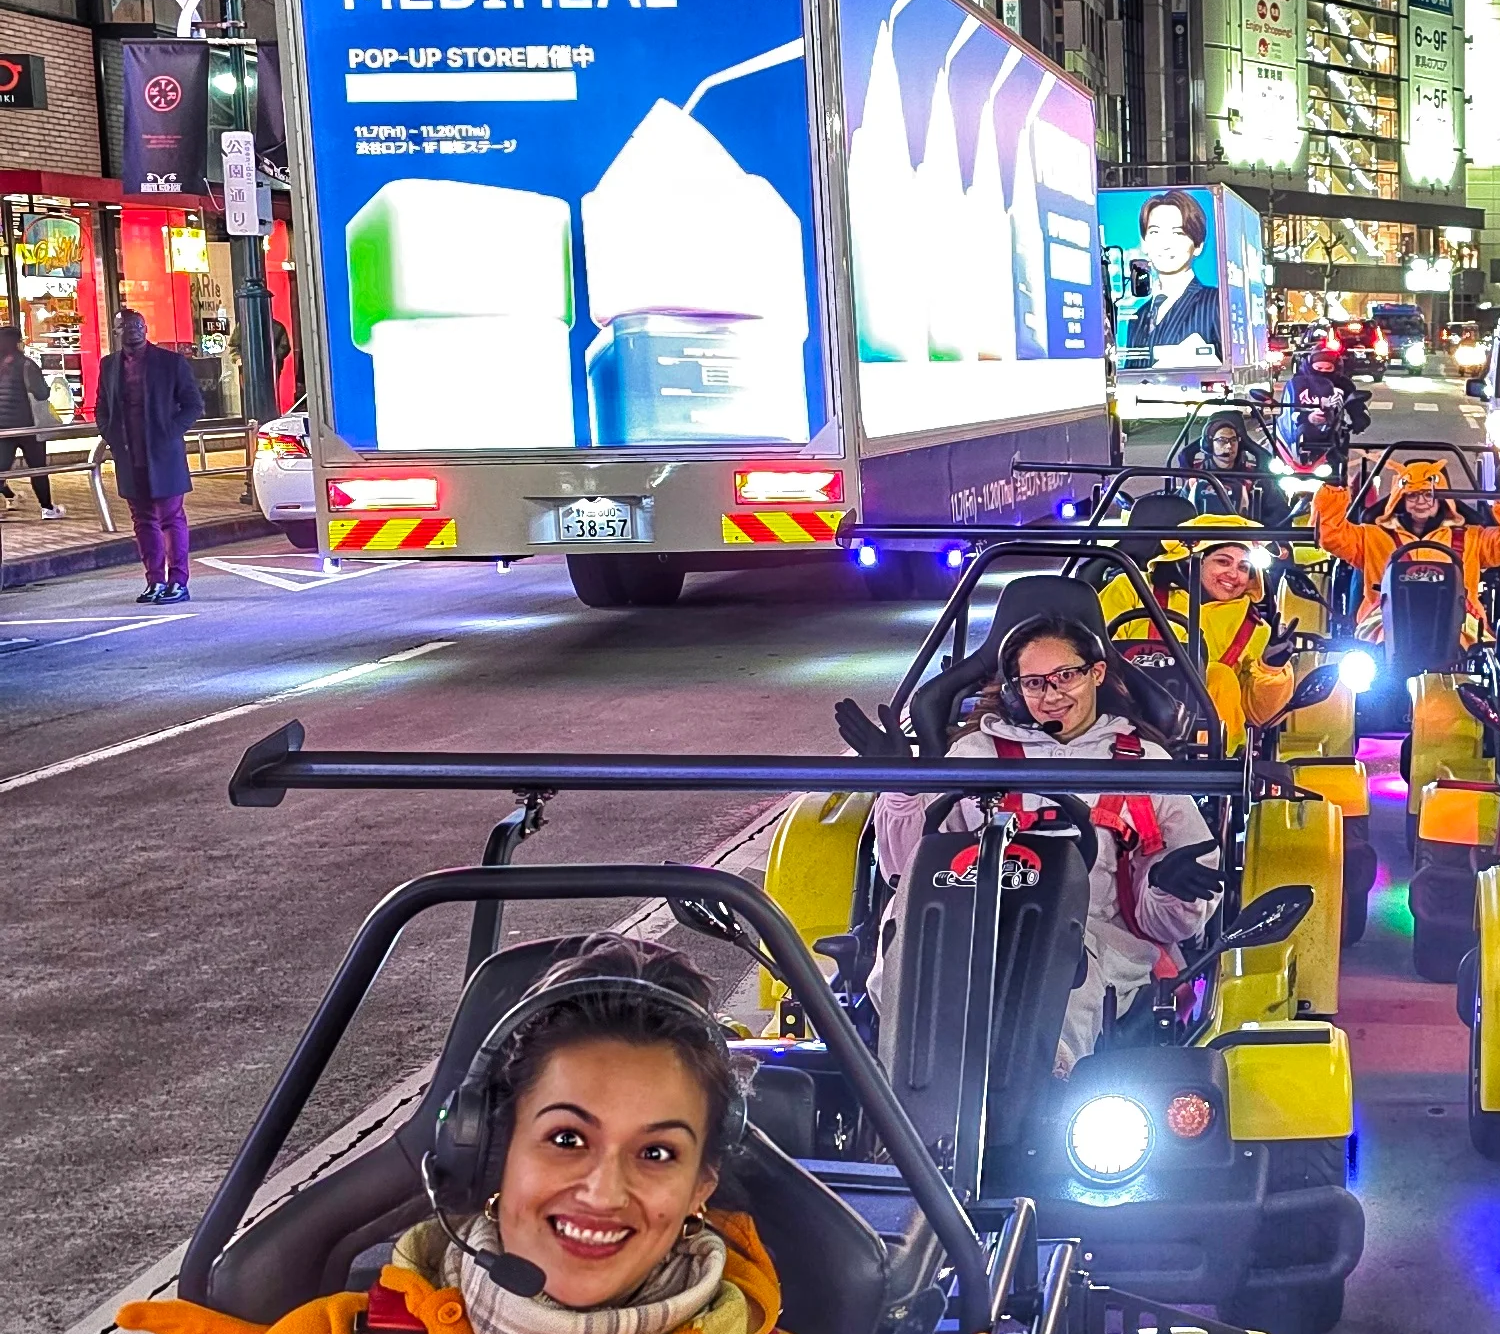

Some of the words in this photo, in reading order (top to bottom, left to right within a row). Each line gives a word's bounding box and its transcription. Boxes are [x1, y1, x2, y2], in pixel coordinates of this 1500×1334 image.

[1245, 19, 1263, 33] Enjoy
[1263, 22, 1293, 39] Shopping!
[348, 47, 442, 69] POP-UP
[227, 139, 247, 226] 公園通り
[575, 519, 628, 537] 38-57
